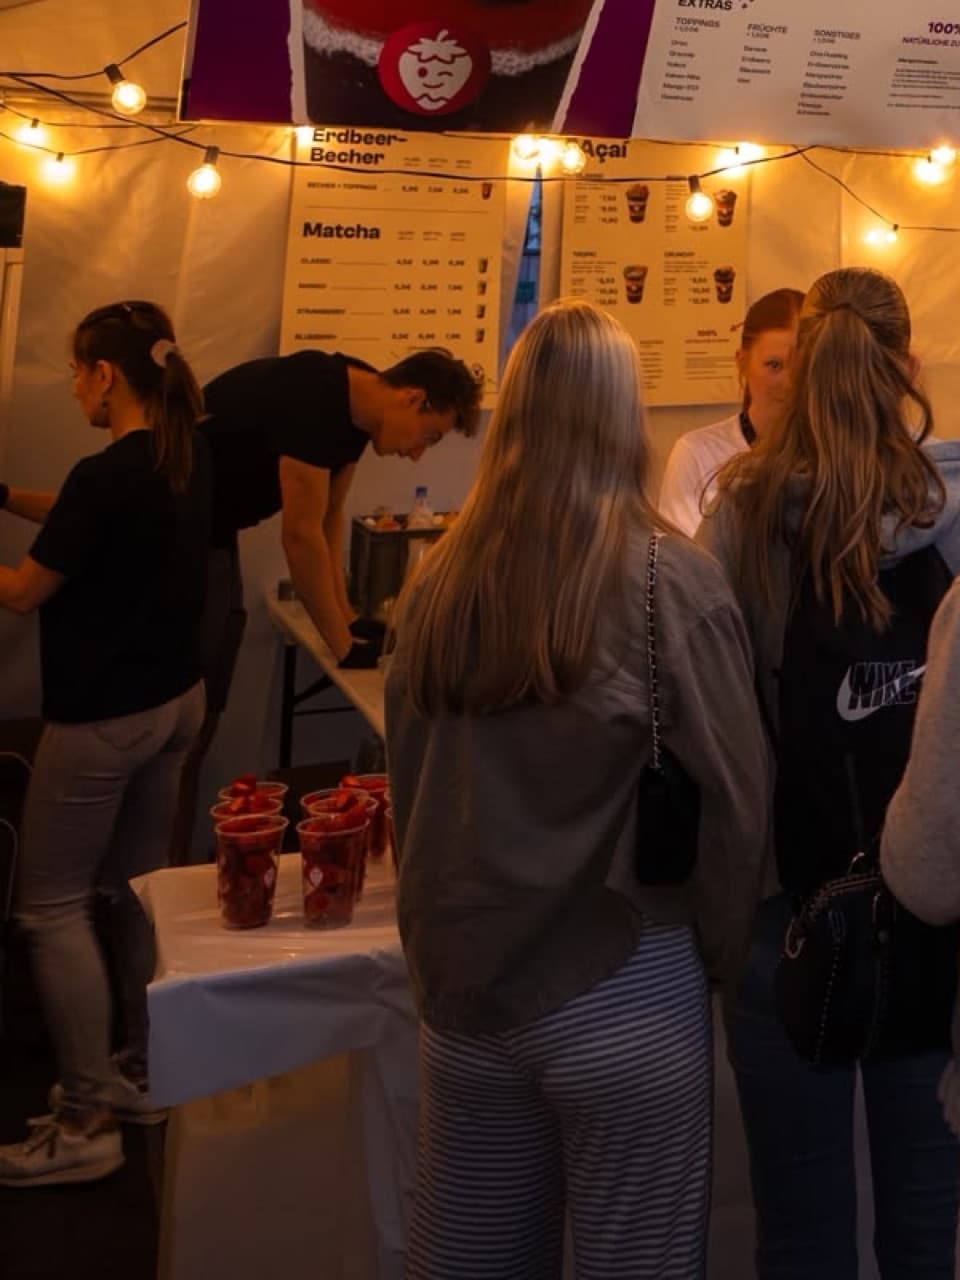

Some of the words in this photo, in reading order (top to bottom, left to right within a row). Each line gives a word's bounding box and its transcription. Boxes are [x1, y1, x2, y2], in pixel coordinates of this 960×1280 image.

[310, 147, 385, 165] Becher
[303, 222, 381, 239] Matcha
[849, 659, 917, 711] NIKE
